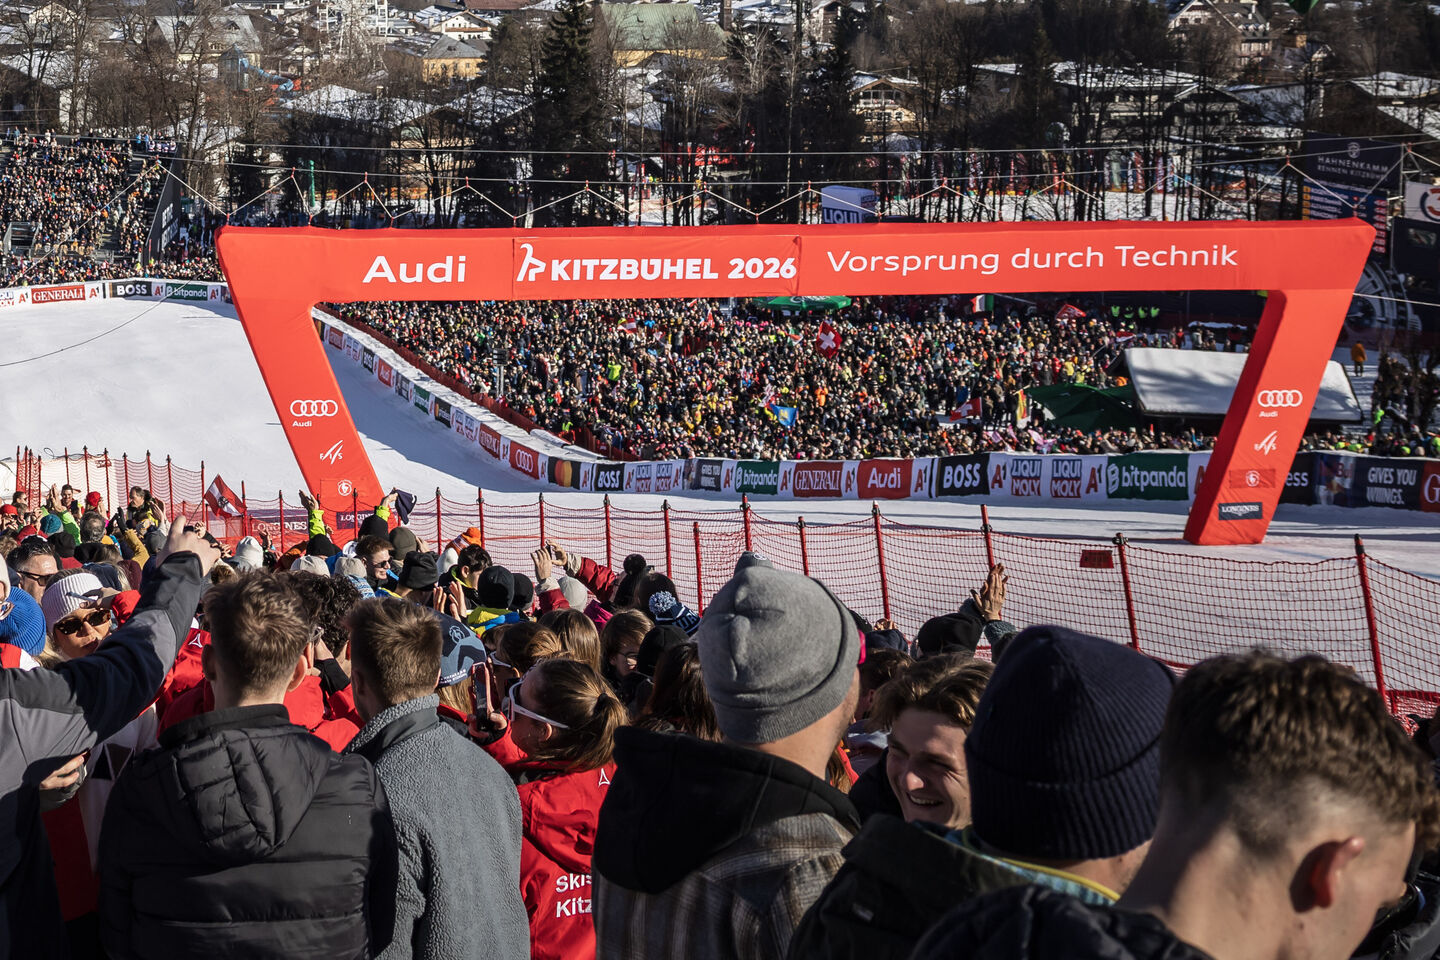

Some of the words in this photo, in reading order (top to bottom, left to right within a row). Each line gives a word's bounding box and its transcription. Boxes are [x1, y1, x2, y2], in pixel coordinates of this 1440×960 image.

[1317, 156, 1388, 172] HAHNENKAMM
[362, 255, 466, 283] Audi
[728, 257, 797, 279] 2026
[827, 250, 1000, 276] Vorsprung
[1011, 247, 1104, 269] durch
[1114, 245, 1239, 267] Technik
[33, 288, 84, 302] GENERALI
[116, 285, 148, 296] BOSS
[867, 467, 901, 489] Audi
[943, 463, 981, 489] BOSS
[1012, 459, 1042, 478] LIQUI
[1052, 459, 1082, 478] LIQUI
[1121, 464, 1186, 491] bitpanda
[1368, 467, 1395, 484] GIVES
[1396, 469, 1417, 485] YOU
[597, 470, 620, 488] BOSS
[744, 469, 778, 489] bitpanda
[795, 470, 841, 490] GENERALI
[1012, 479, 1041, 496] MOLY
[1052, 479, 1081, 497] MOLY
[1221, 504, 1260, 513] LONGINES
